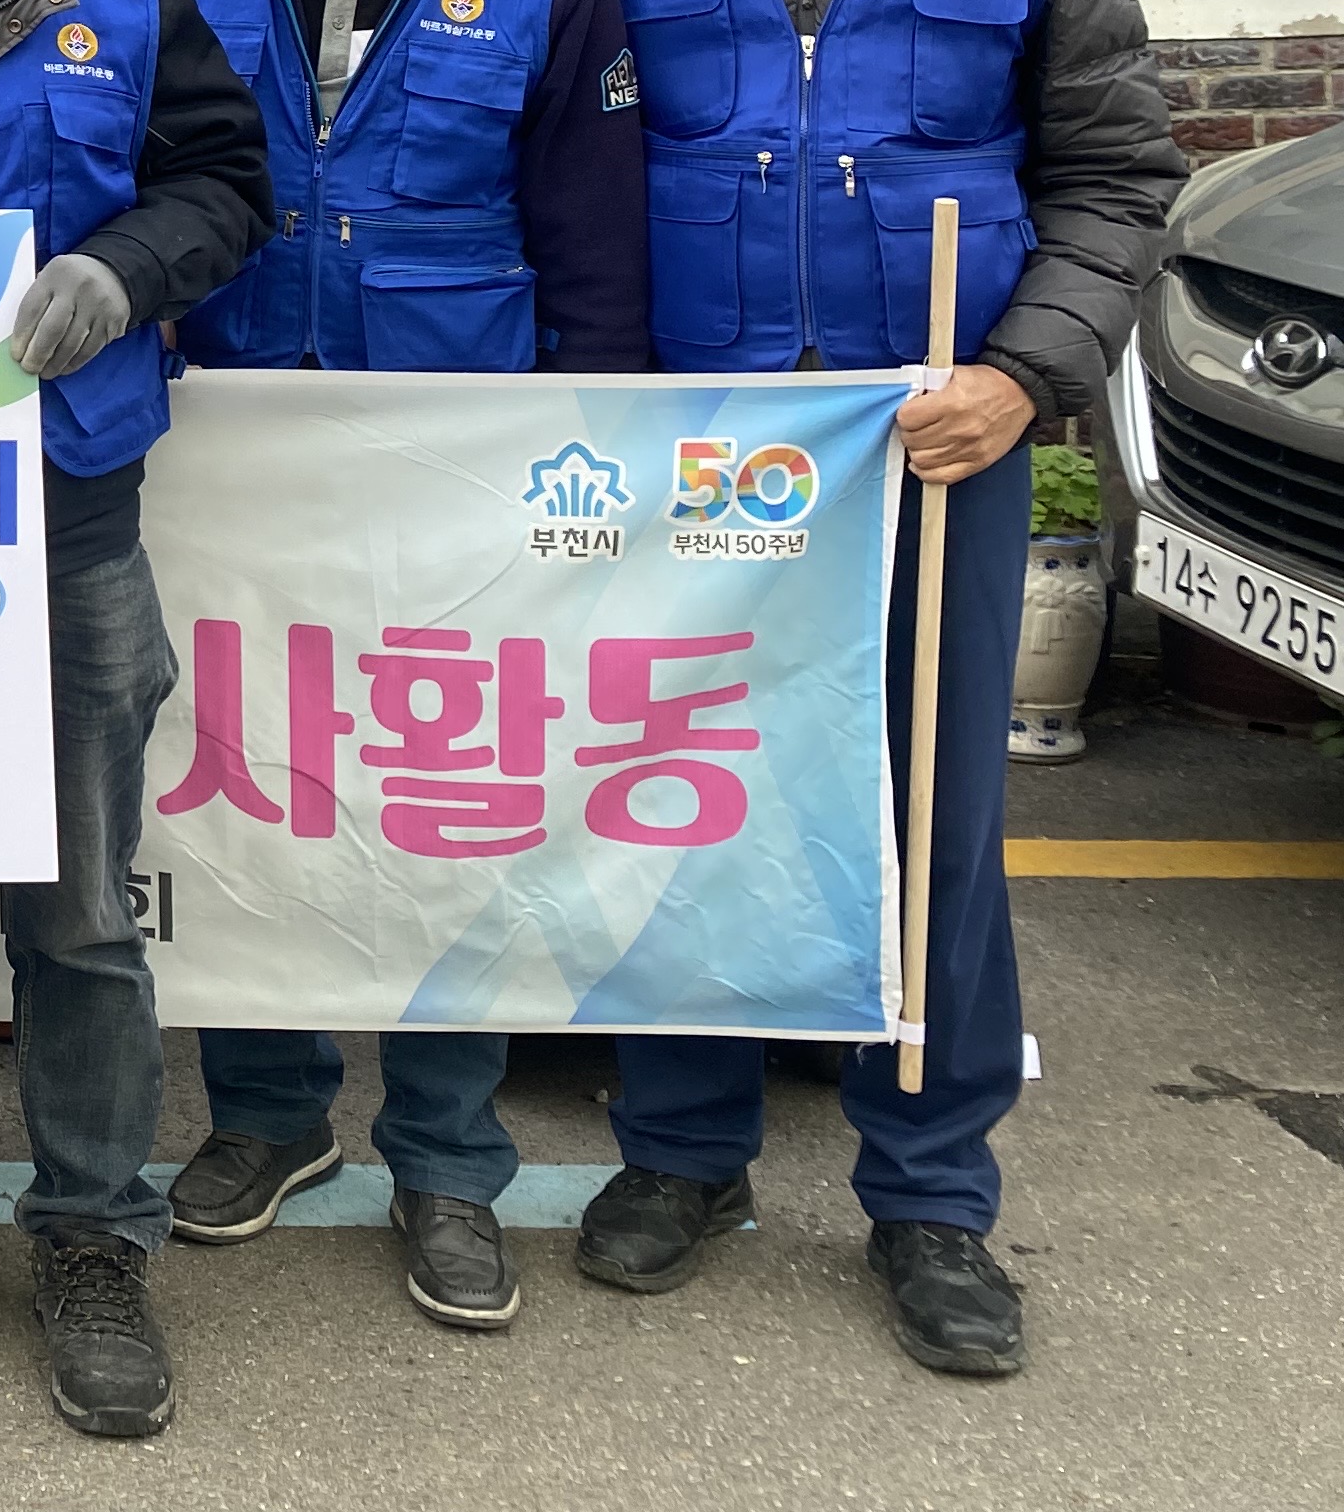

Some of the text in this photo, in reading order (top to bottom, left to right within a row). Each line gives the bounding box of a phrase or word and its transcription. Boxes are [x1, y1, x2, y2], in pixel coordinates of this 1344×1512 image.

[420, 18, 496, 41] 바르게살기운동
[43, 62, 114, 81] 바르게살기운동
[668, 440, 815, 525] 50
[531, 527, 619, 557] 부천시
[674, 533, 805, 555] 부천시 50주년
[1157, 537, 1336, 675] 14수 9255
[156, 618, 761, 859] 사활동
